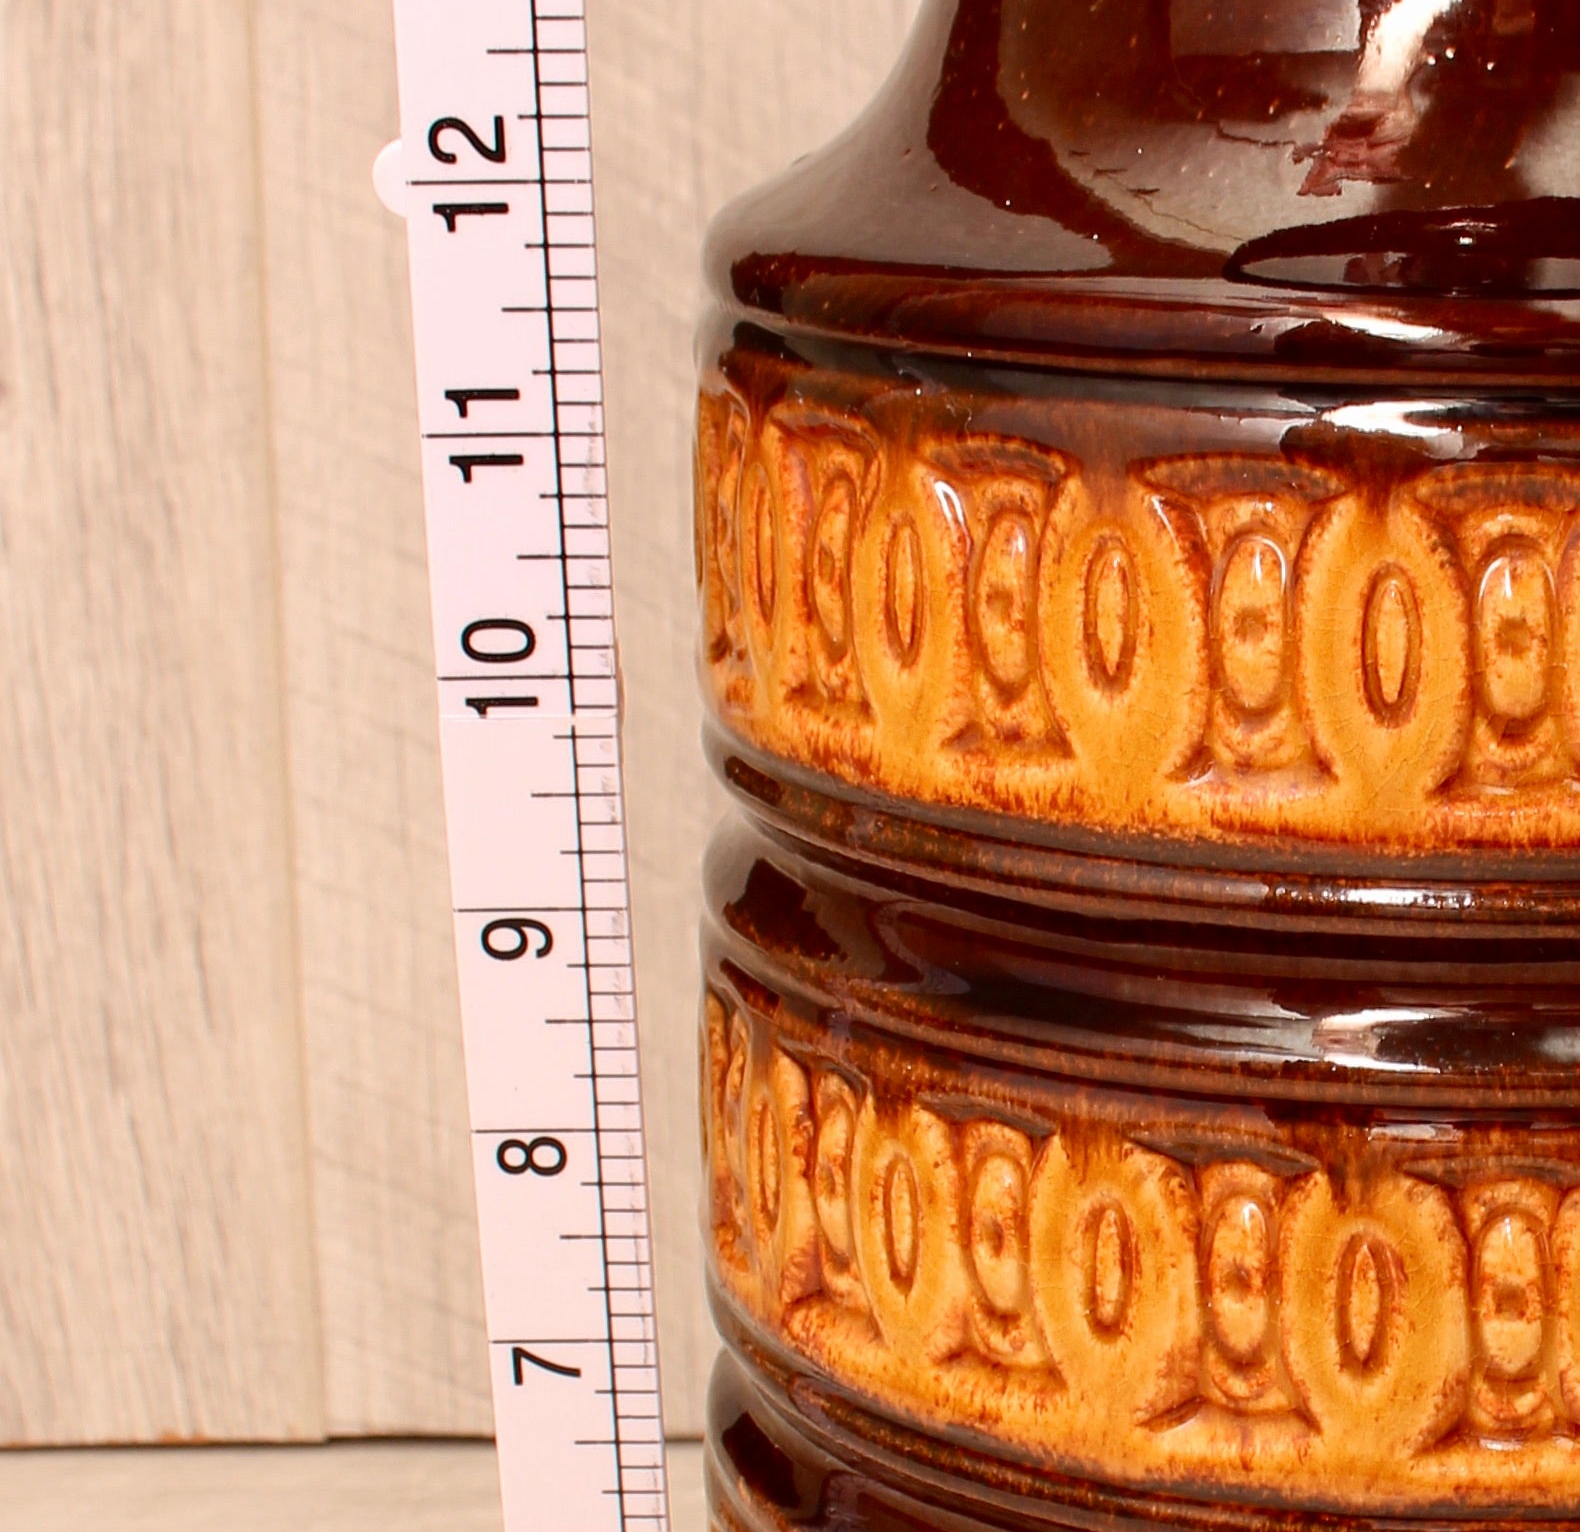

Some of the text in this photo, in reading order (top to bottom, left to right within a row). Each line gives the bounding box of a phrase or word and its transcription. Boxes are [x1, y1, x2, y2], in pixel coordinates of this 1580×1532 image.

[427, 114, 509, 234] 12
[444, 387, 524, 485] 11
[461, 618, 540, 720] 10
[480, 917, 554, 962] 9
[496, 1135, 568, 1178] 8
[511, 1346, 582, 1387] 7
